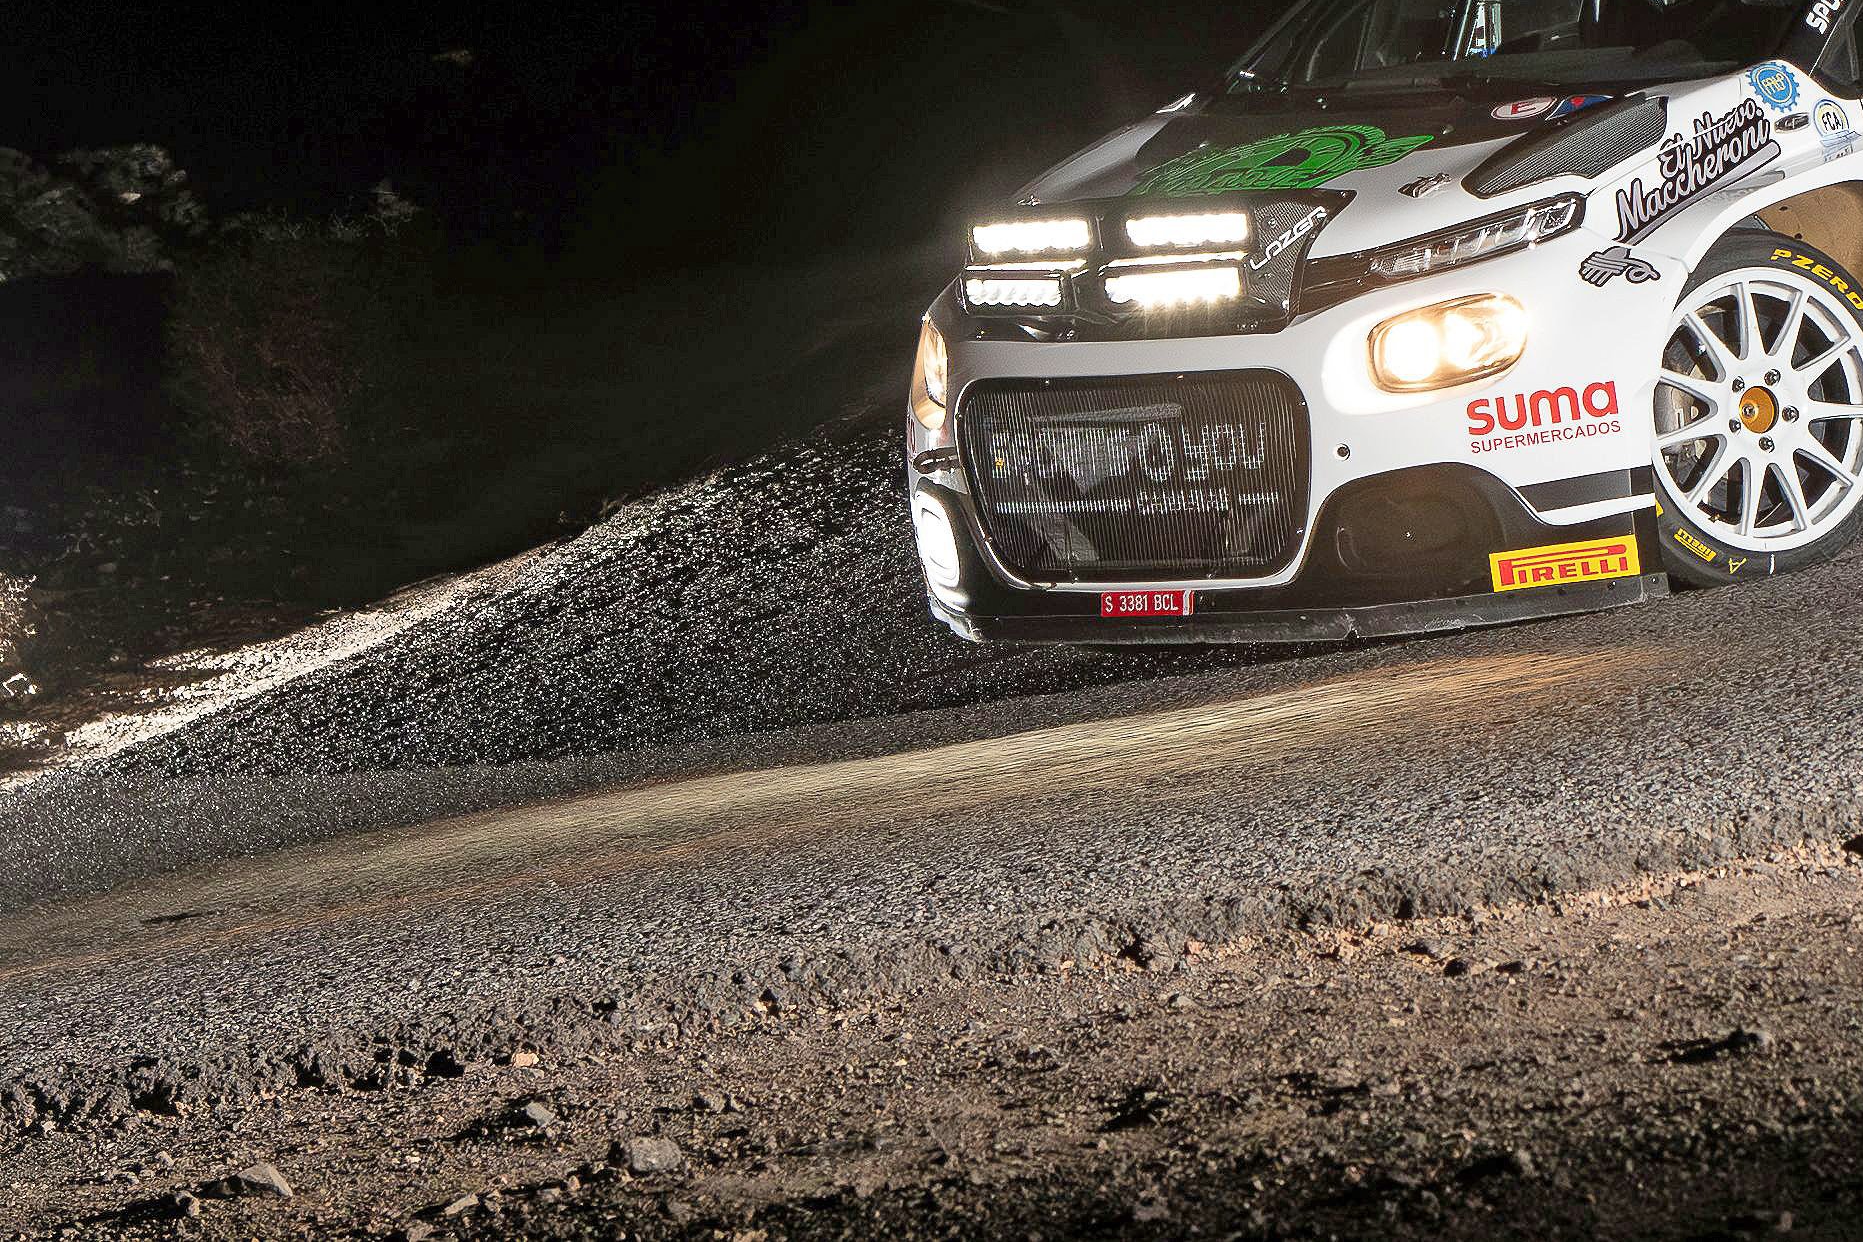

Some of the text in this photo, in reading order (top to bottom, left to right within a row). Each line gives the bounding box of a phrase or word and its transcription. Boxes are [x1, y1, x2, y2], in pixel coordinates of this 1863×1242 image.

[1821, 111, 1844, 131] FCA
[1612, 108, 1771, 240] Maccheroni
[1658, 133, 1686, 178] El
[1249, 206, 1327, 270] LAZER
[1466, 381, 1619, 435] suma
[1471, 420, 1621, 453] SUPERMERCADOS
[1498, 544, 1629, 586] PIRELLI
[1105, 593, 1179, 613] S 3381 BCL
